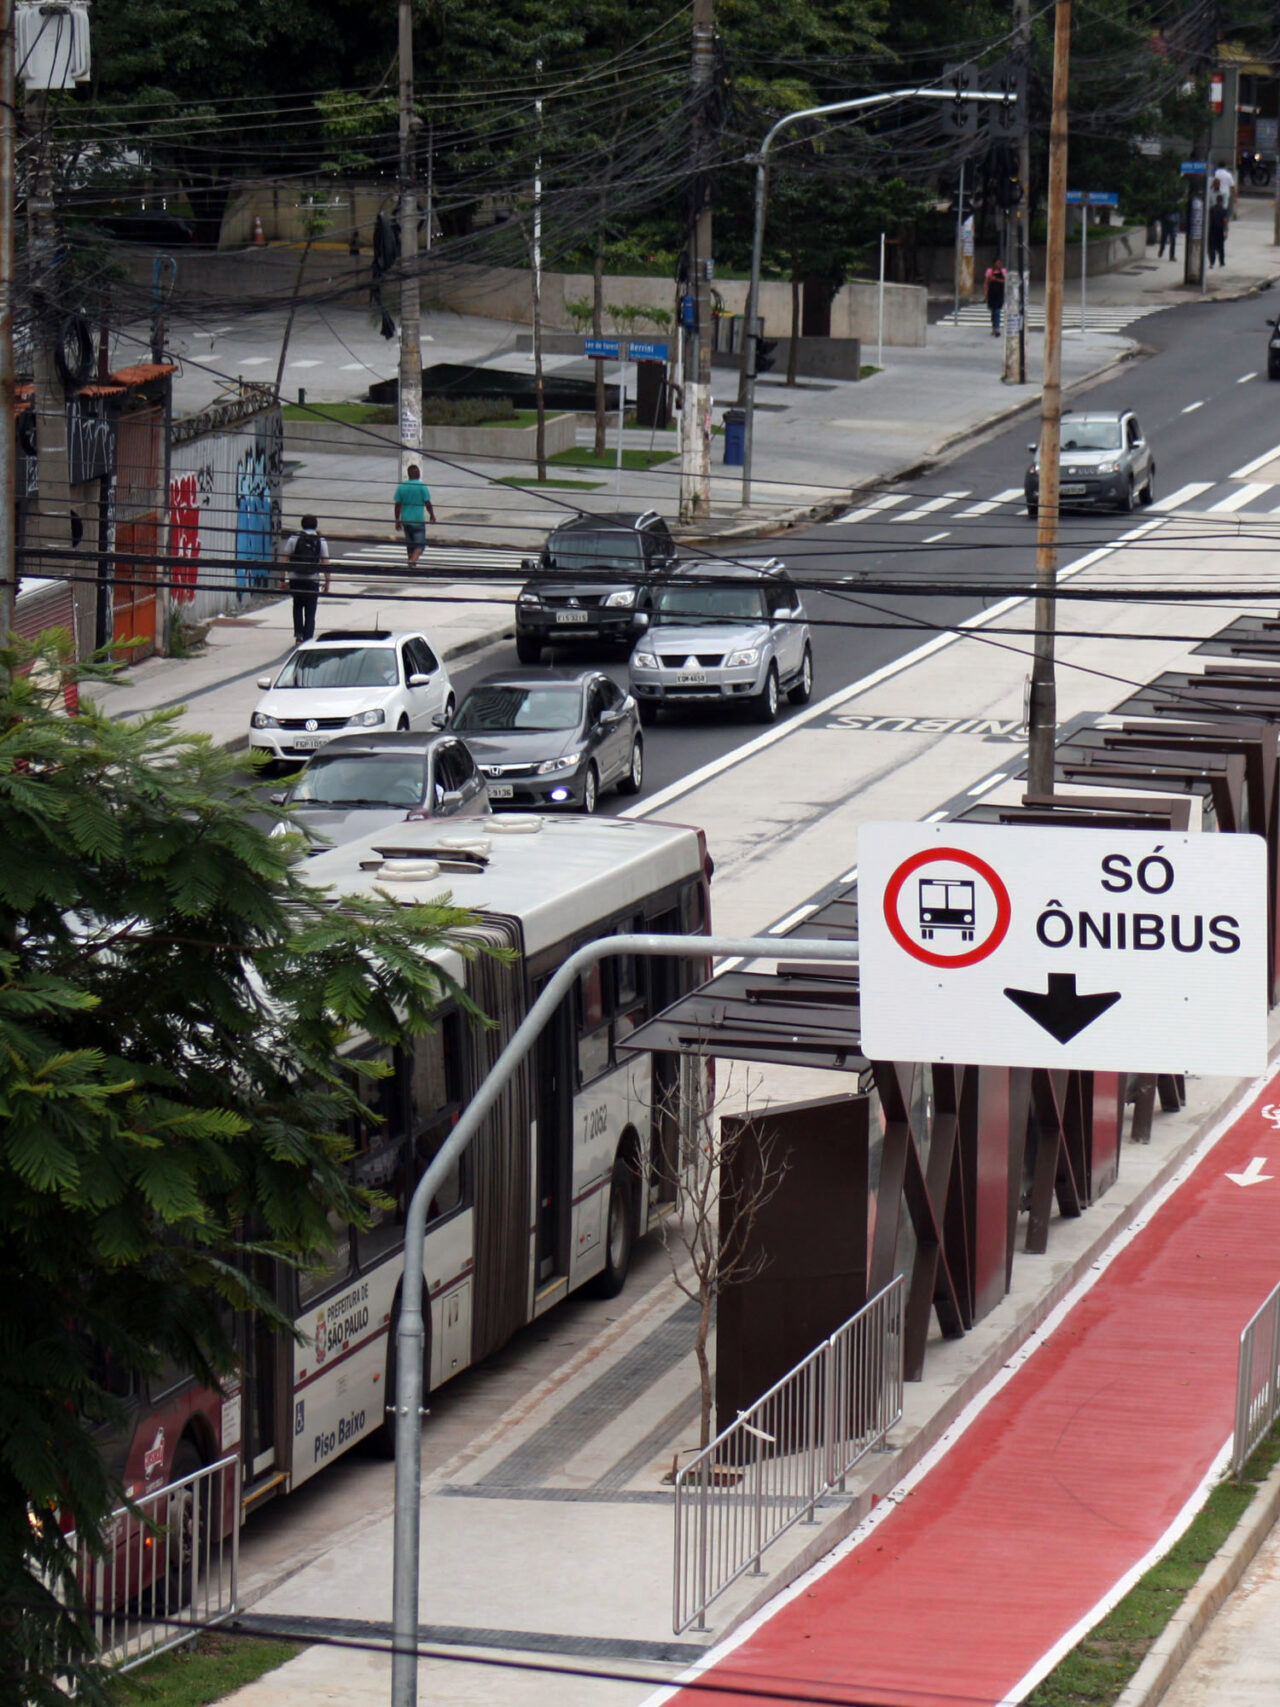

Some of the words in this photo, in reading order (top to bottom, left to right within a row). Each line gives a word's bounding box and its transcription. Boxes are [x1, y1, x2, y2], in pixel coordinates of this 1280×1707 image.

[826, 716, 1030, 742] NIBUS
[1101, 845, 1174, 894] SÓ
[1036, 899, 1241, 954] ÔNIBUS
[327, 1288, 360, 1323] PREFEITURA
[361, 1282, 369, 1301] DE
[327, 1321, 343, 1352] SÃO
[344, 1306, 369, 1340] PAULO
[314, 1432, 336, 1464] Piso
[338, 1410, 366, 1446] Baixo
